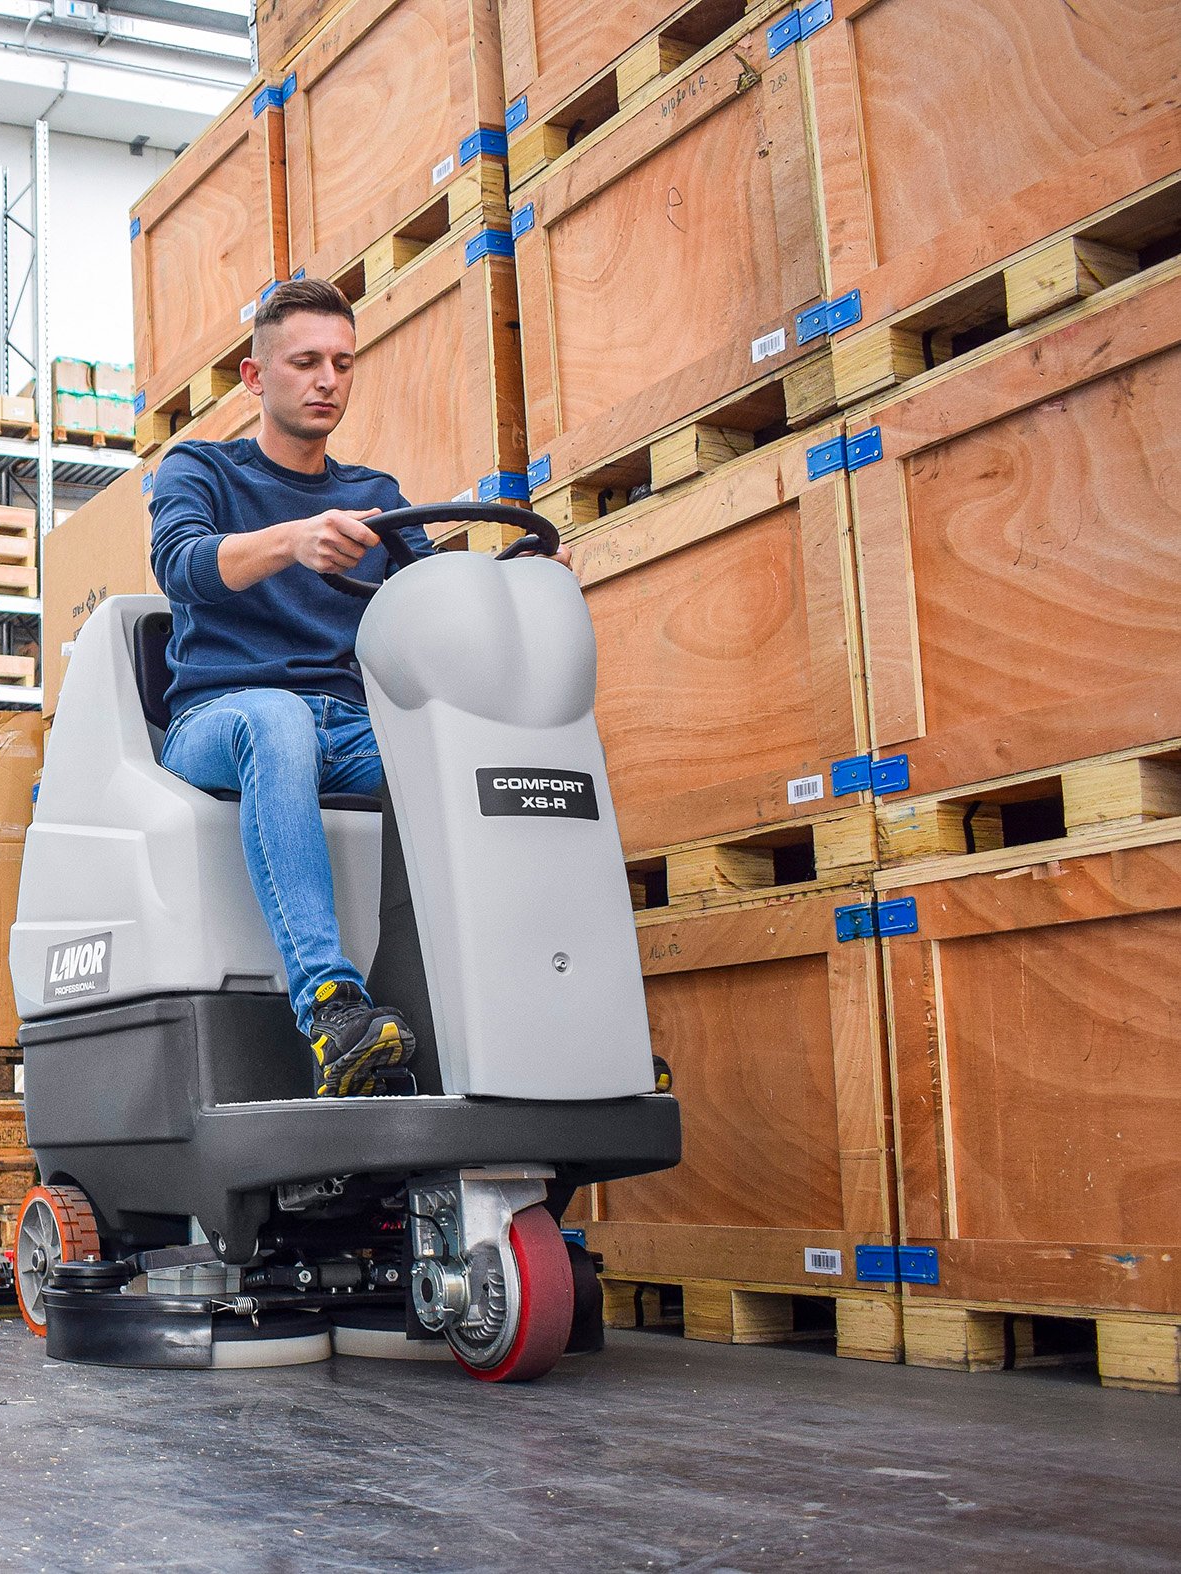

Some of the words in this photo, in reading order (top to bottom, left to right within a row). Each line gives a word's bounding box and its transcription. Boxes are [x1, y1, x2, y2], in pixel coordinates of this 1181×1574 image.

[492, 778, 584, 793] COMFORT
[521, 796, 567, 809] XS-R
[50, 940, 106, 982] LAVOR
[54, 980, 96, 996] PROFESSIONAL
